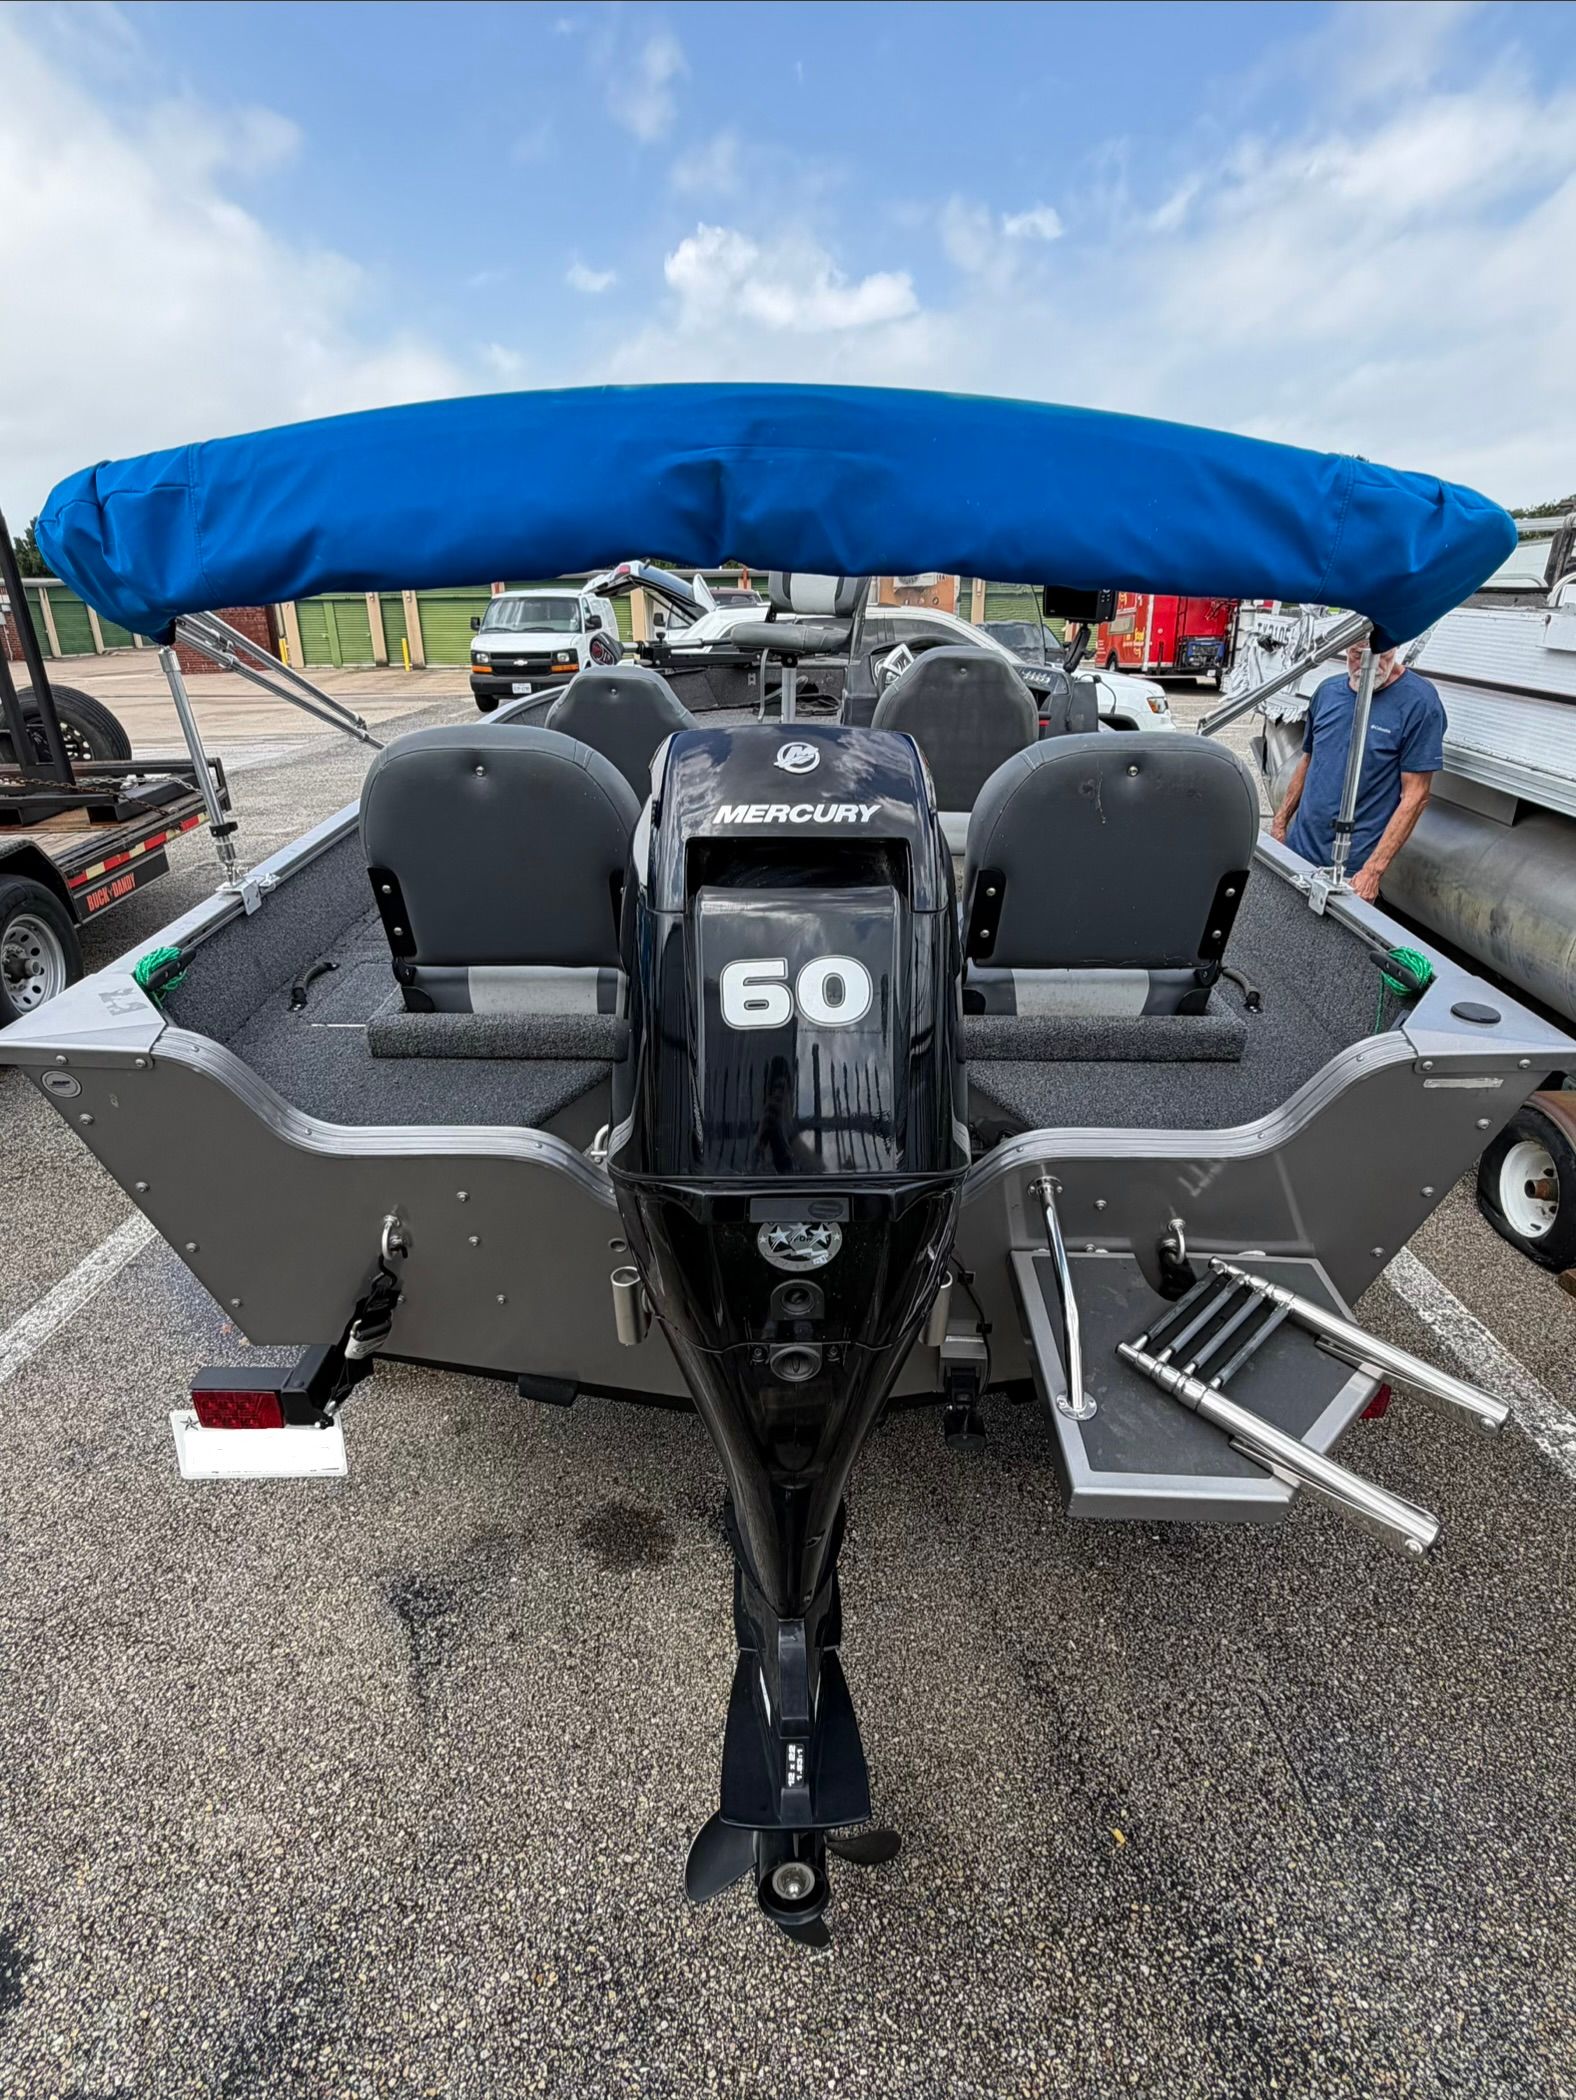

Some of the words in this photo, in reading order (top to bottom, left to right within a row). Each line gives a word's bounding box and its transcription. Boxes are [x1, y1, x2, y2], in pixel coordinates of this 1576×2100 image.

[713, 804, 883, 824] MERCURY
[86, 886, 110, 912] BUCK
[112, 872, 136, 897] DANDY
[720, 955, 873, 1030] 60
[788, 1744, 796, 1761] 22
[788, 1772, 795, 1787] 12
